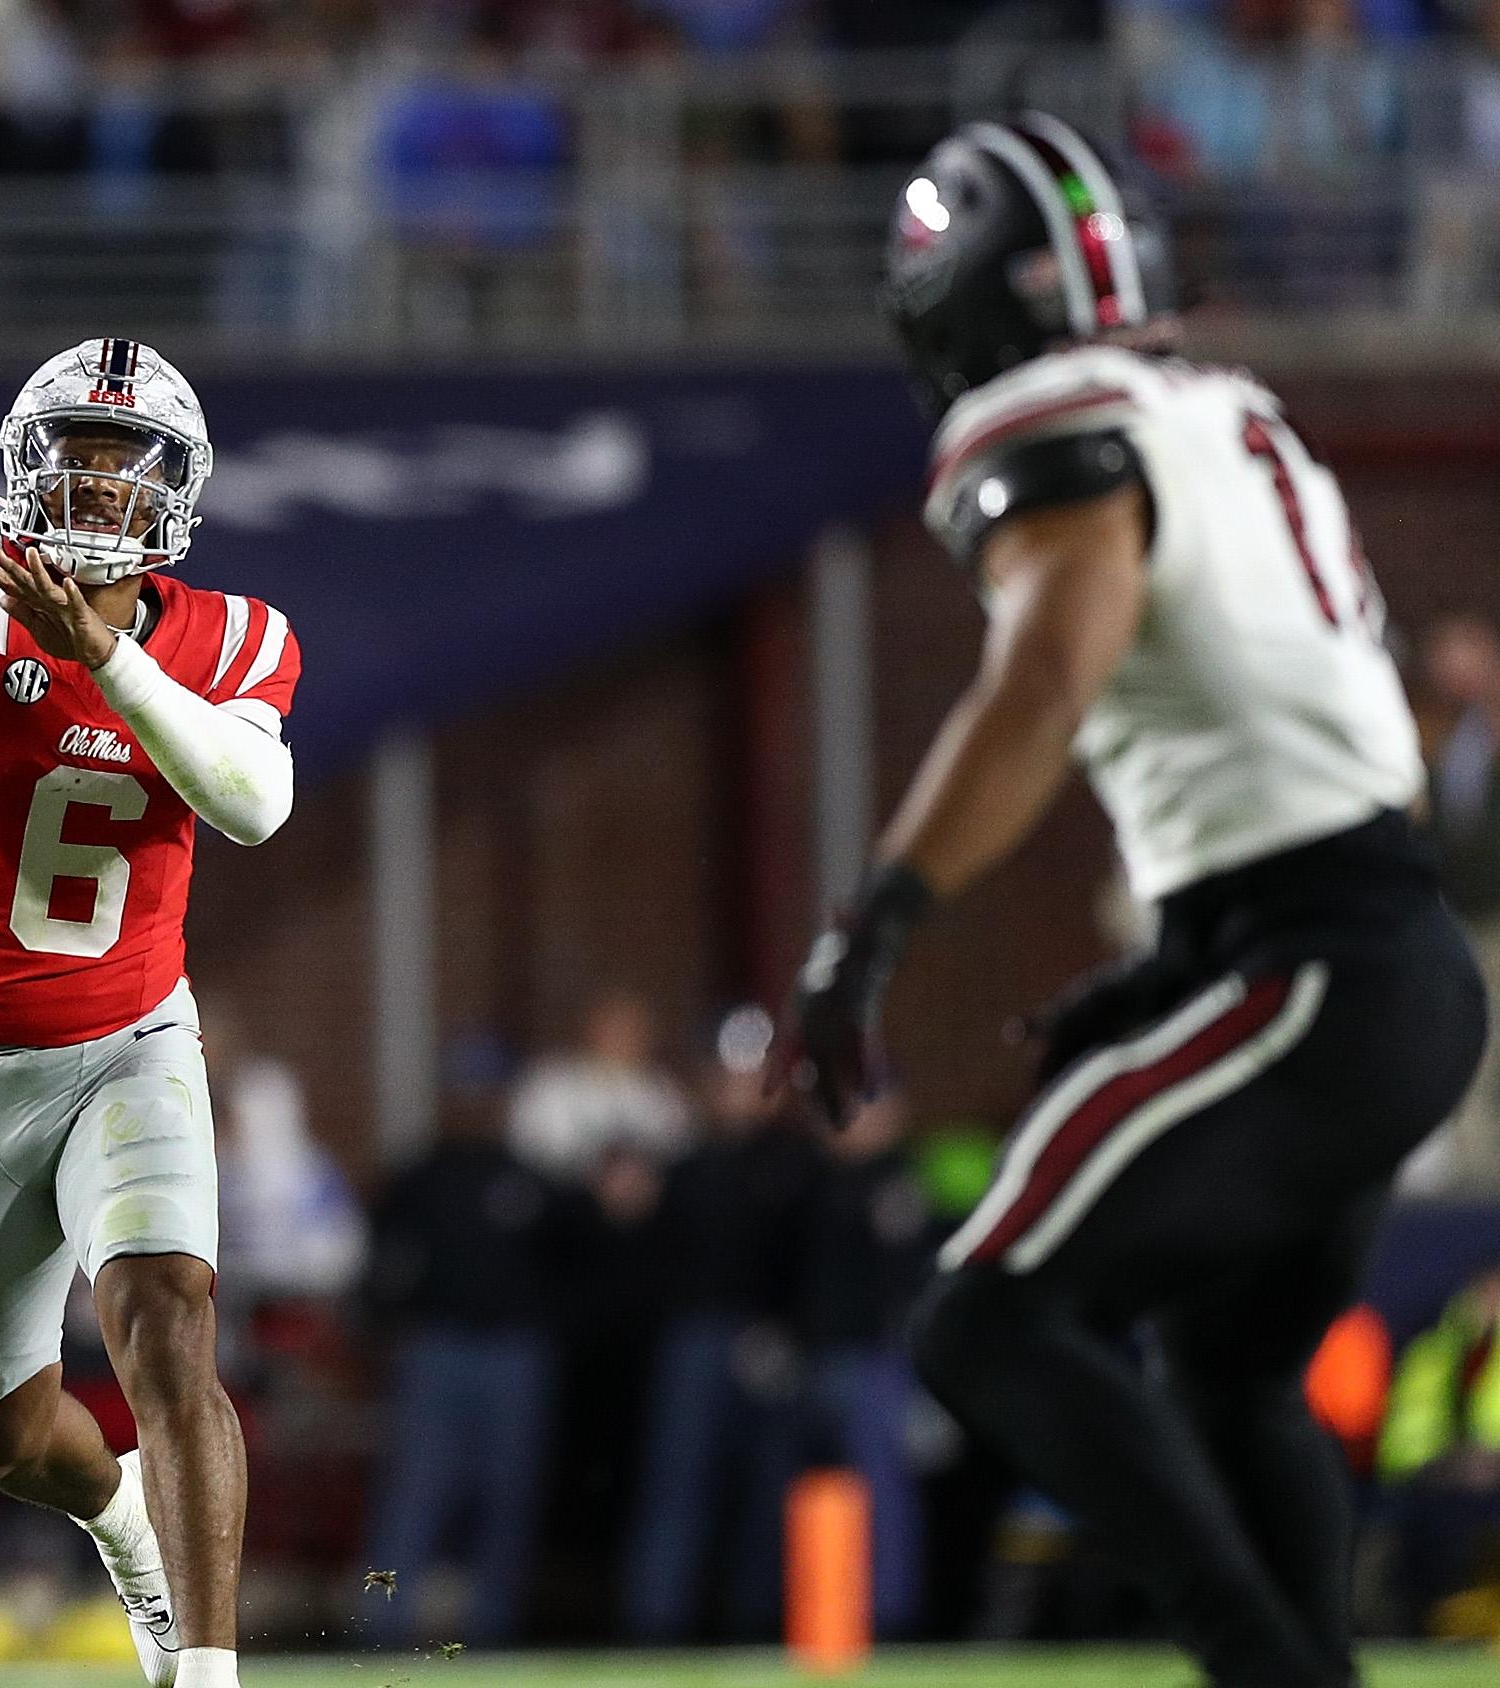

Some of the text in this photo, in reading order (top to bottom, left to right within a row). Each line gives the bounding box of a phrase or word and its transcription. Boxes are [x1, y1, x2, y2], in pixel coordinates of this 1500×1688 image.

[88, 389, 136, 409] REBS
[4, 658, 50, 704] SEC
[58, 724, 132, 764] Ole Miss
[9, 764, 149, 959] 6
